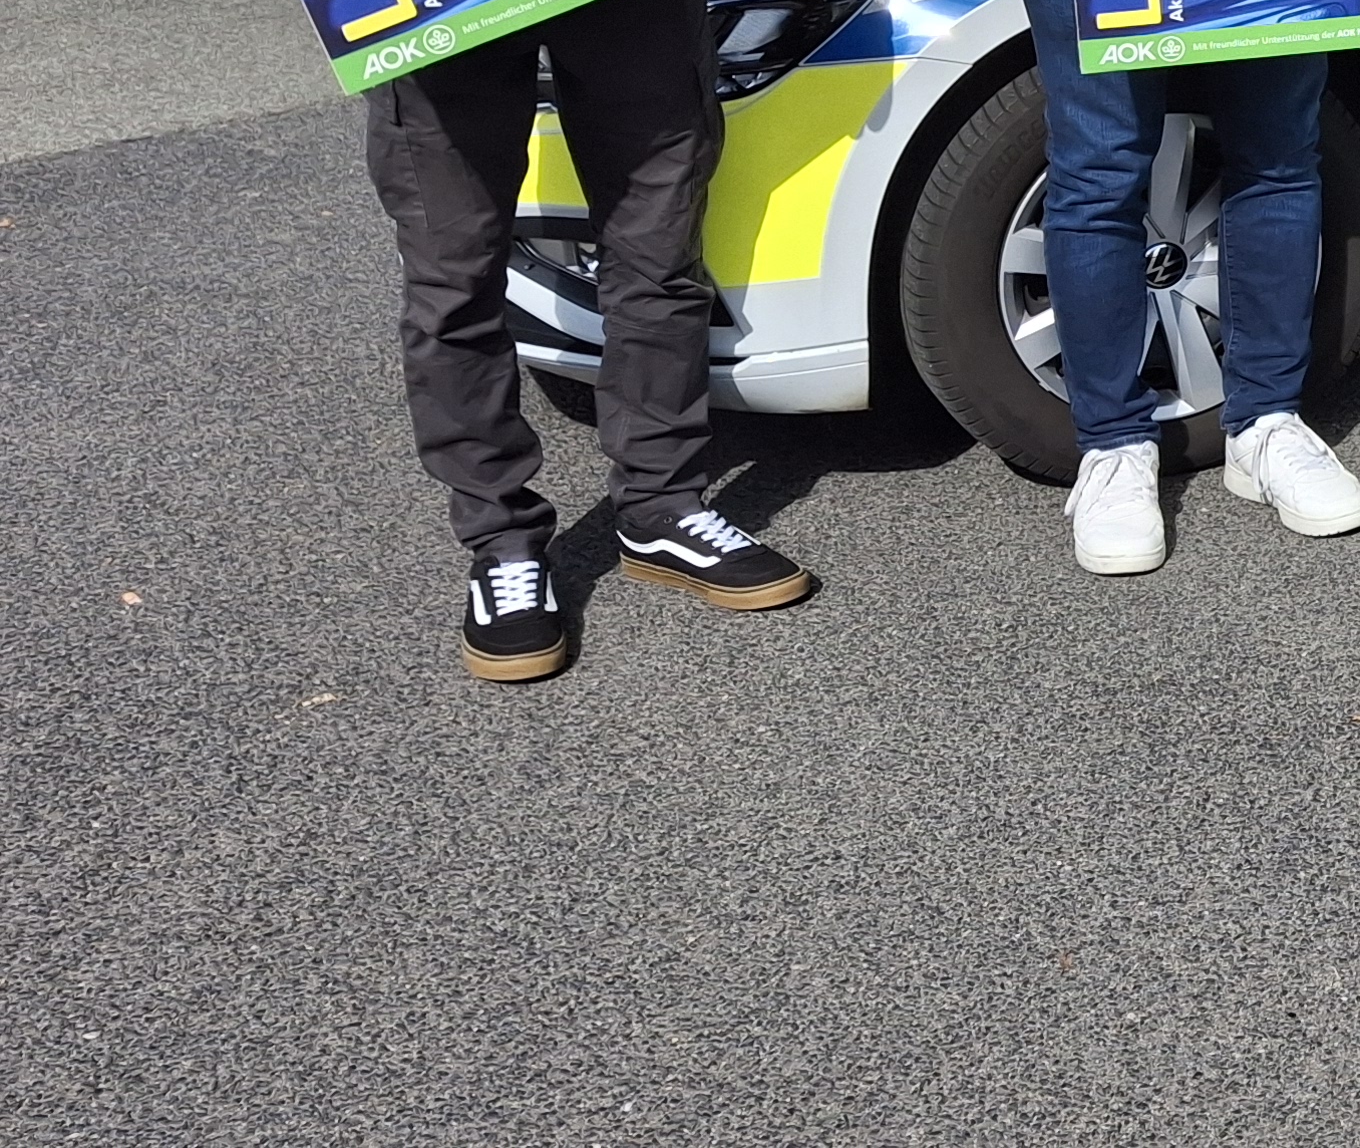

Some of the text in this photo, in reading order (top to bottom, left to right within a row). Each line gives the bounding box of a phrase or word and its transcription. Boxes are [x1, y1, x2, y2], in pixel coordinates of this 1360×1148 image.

[461, 19, 479, 35] Mit
[1193, 41, 1208, 51] Mit
[1209, 37, 1260, 50] freundlicher
[1262, 31, 1321, 46] Unterstützung
[1321, 29, 1336, 40] der
[1336, 28, 1356, 38] AOK
[362, 37, 426, 80] AOK
[1099, 40, 1157, 65] AOK
